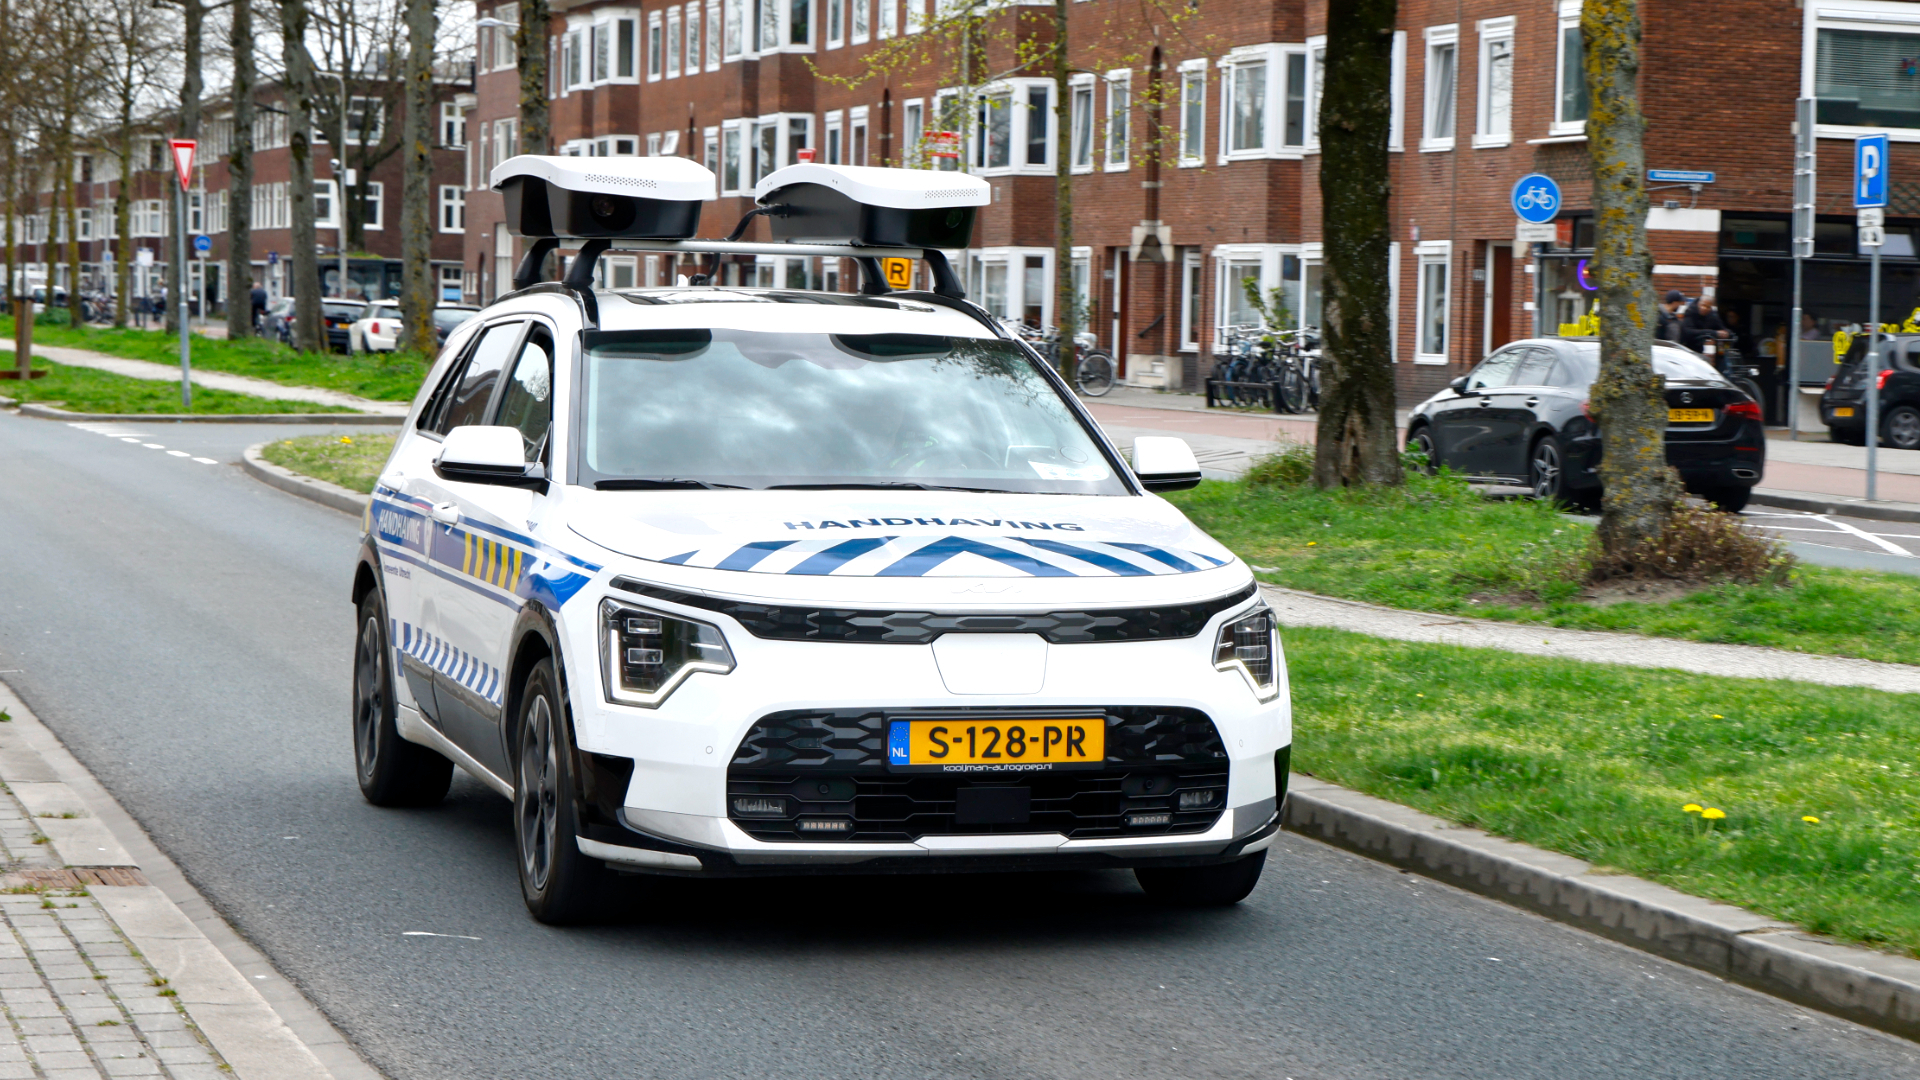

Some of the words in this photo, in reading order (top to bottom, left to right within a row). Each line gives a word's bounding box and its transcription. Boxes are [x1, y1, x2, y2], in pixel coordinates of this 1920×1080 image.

[1861, 145, 1880, 198] P
[890, 262, 904, 281] R
[378, 508, 421, 545] HANDHAVING
[783, 517, 1085, 532] HANDHAVING
[928, 726, 1087, 758] S-128-PR
[892, 747, 907, 757] NL
[943, 763, 1053, 773] kooijman-autogroep.nl
